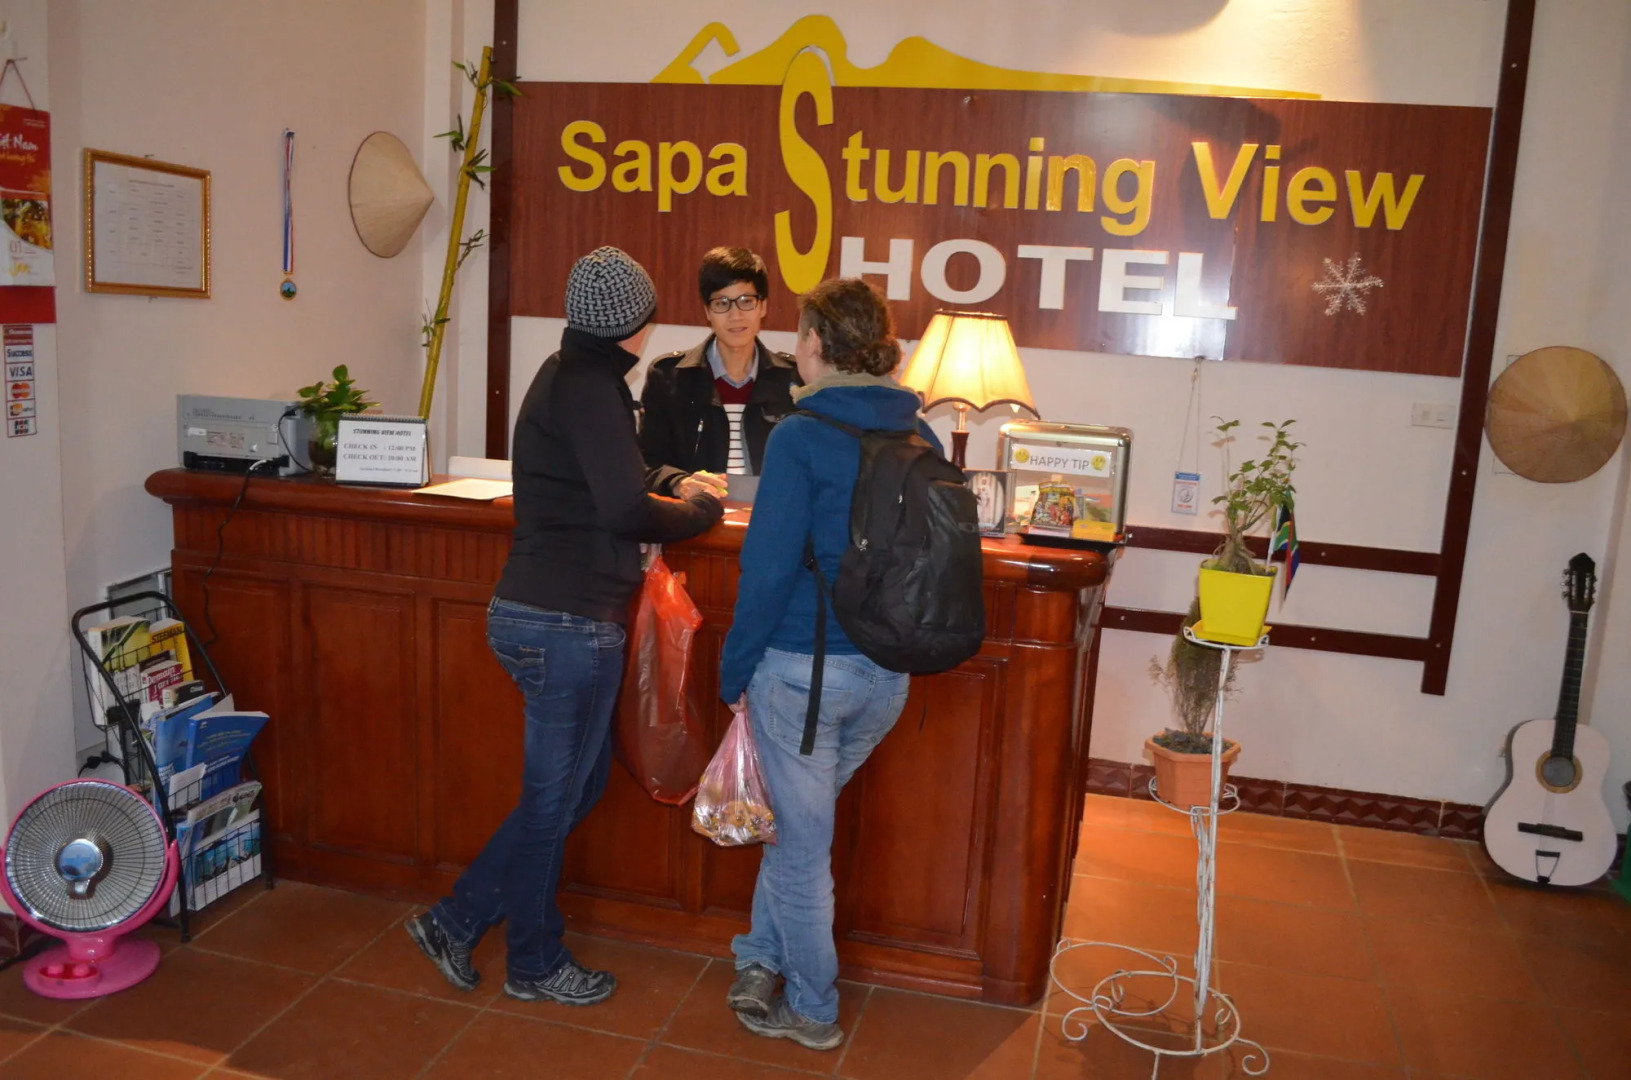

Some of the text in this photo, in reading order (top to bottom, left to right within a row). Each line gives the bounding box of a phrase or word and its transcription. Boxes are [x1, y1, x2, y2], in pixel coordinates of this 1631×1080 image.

[557, 120, 748, 212] Sapa
[1191, 142, 1426, 230] View
[839, 236, 1238, 320] HOTEL
[10, 366, 32, 377] VISA
[343, 453, 368, 461] CHECK
[1029, 455, 1090, 471] HAPPY TIP
